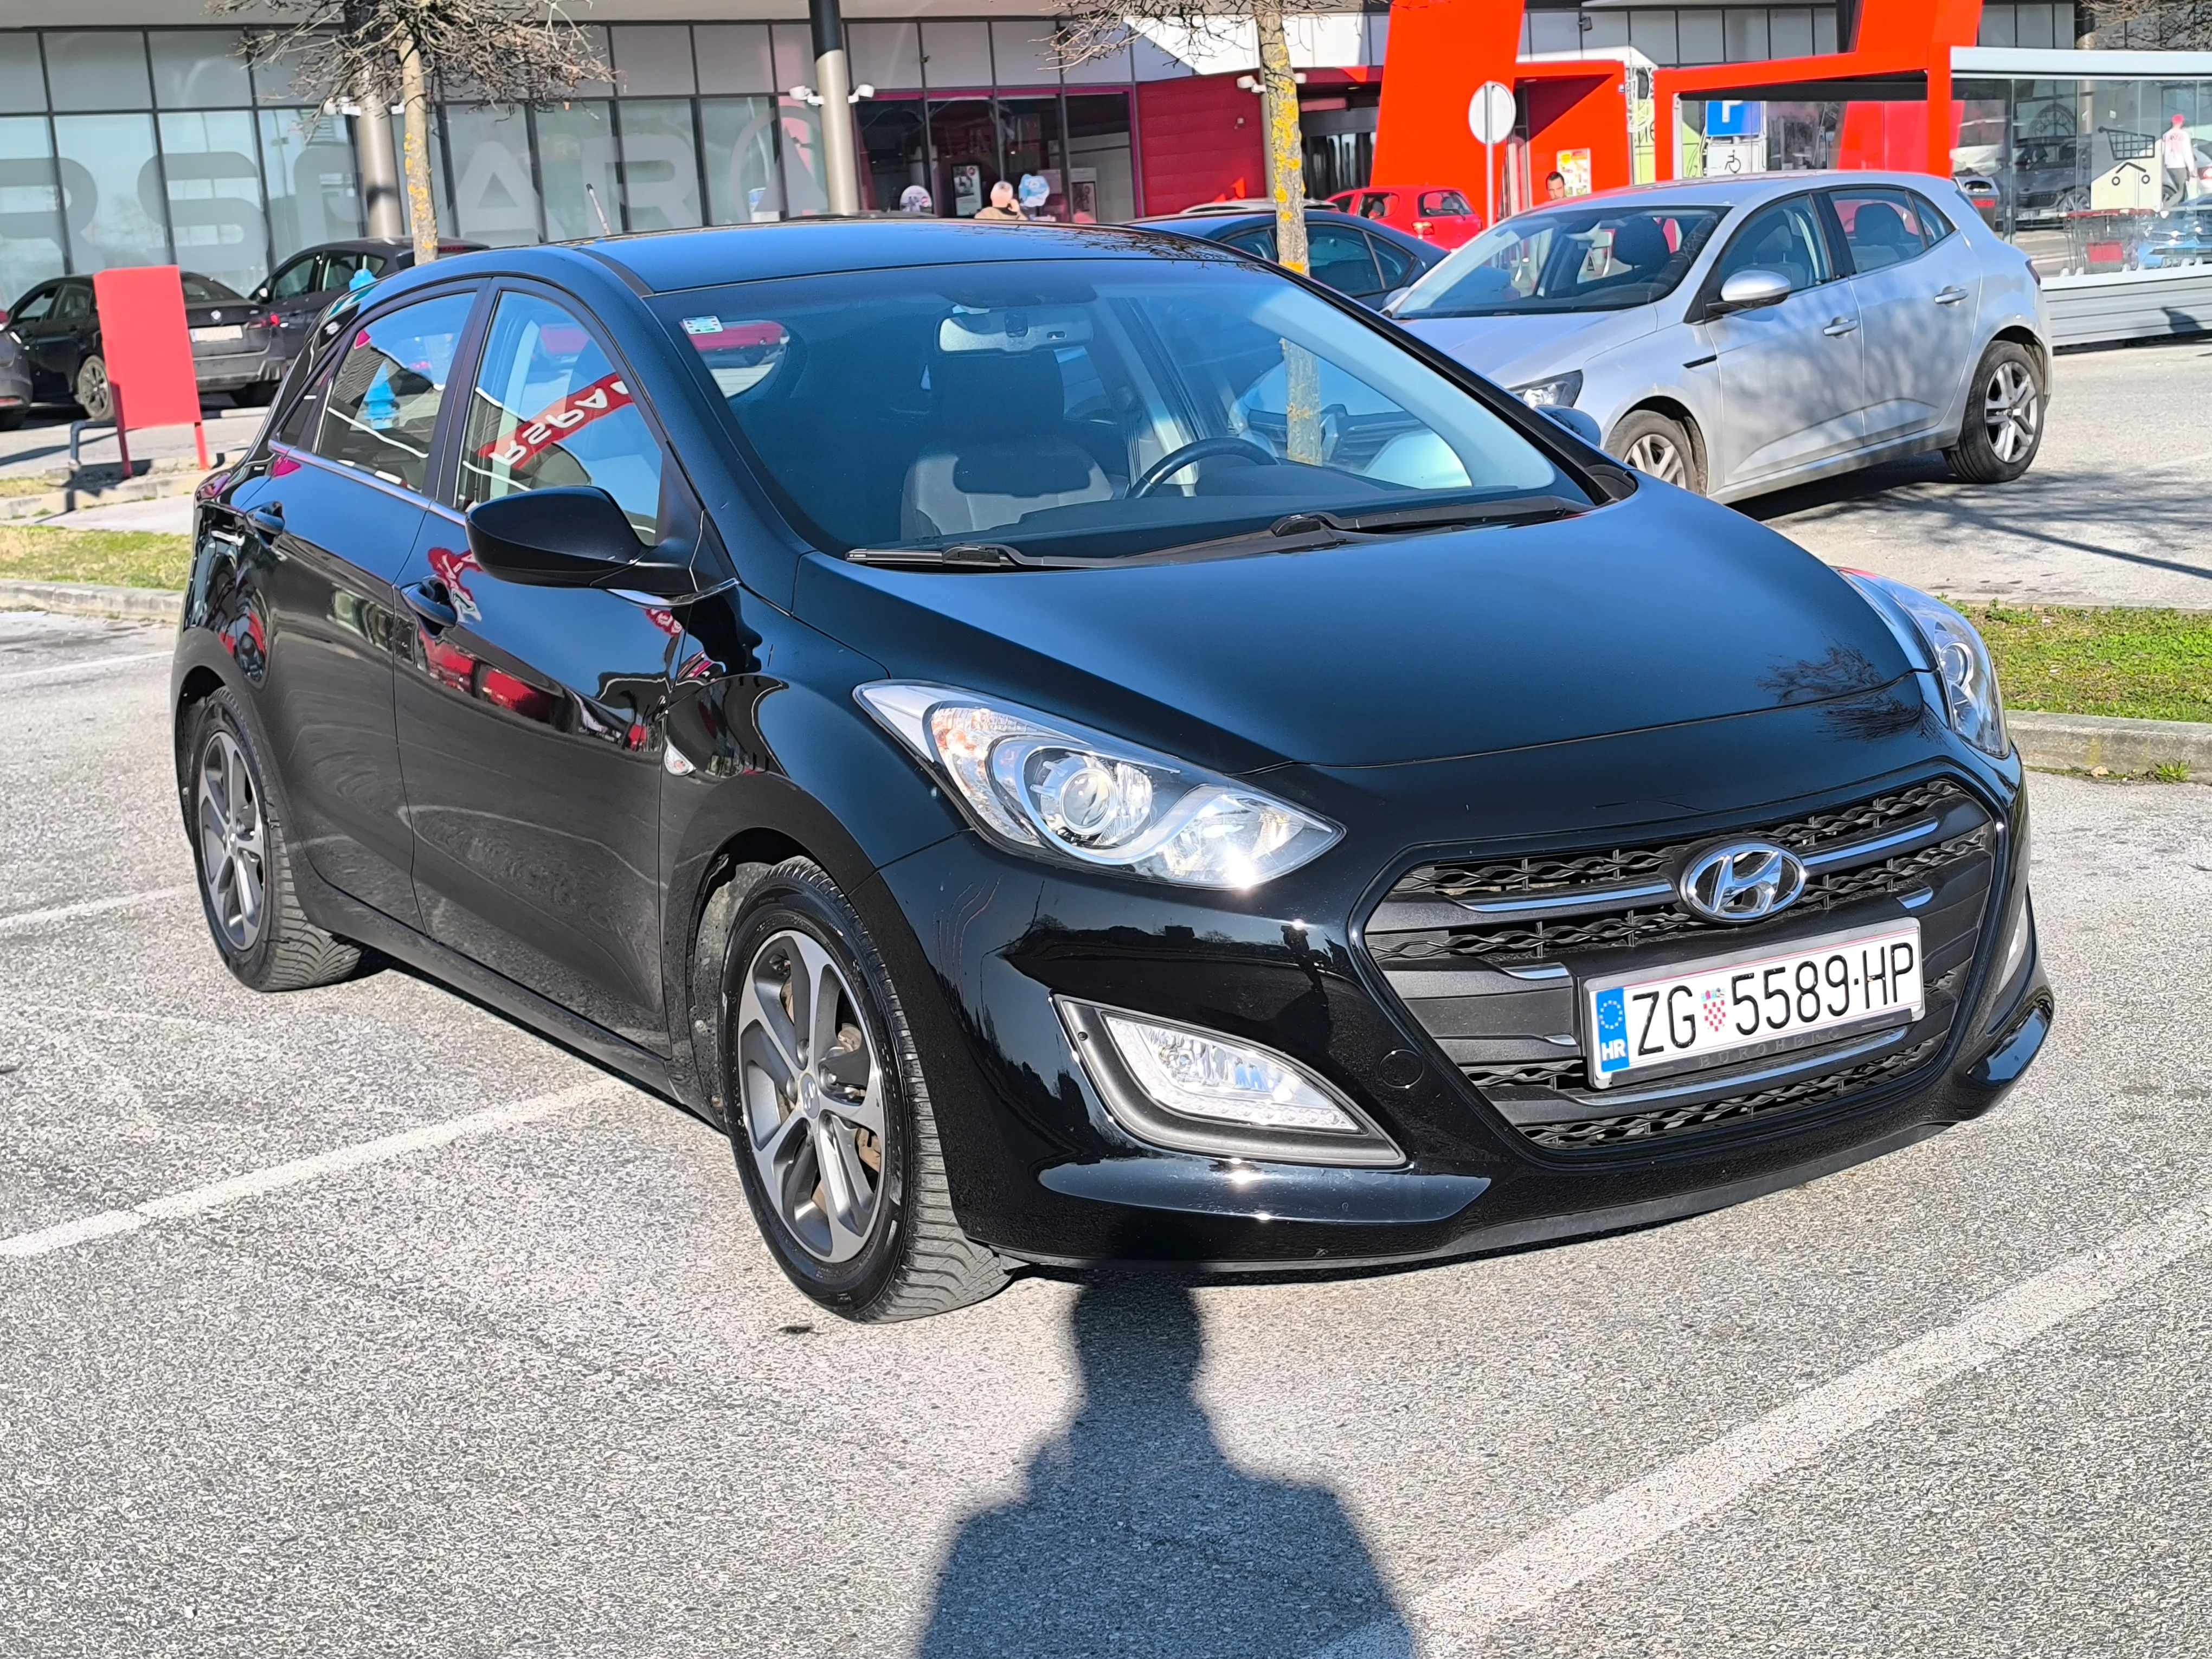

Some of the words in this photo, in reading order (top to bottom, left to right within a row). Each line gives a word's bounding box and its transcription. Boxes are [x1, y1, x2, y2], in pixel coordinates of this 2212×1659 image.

[1632, 985, 1696, 1056] ZG
[1601, 1039, 1626, 1062] HR
[1699, 1027, 1840, 1067] EUROHERC
